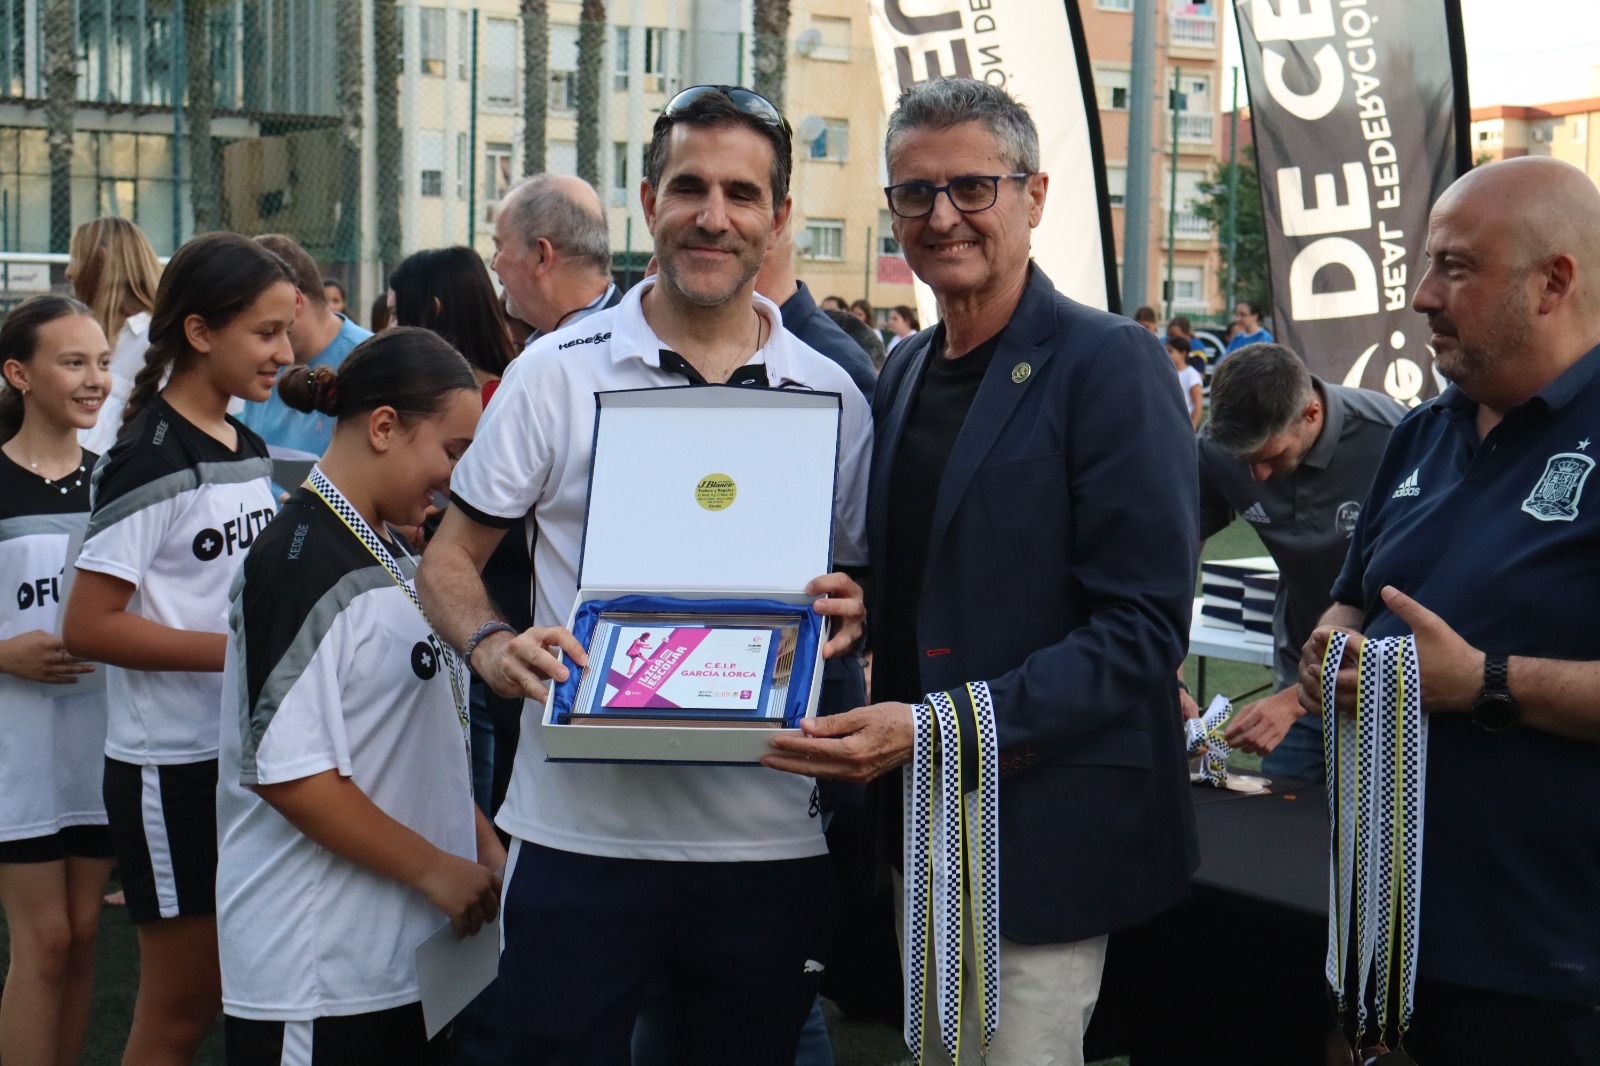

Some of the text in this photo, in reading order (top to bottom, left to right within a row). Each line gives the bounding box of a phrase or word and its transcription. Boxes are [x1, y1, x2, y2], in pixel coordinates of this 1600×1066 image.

[639, 660, 666, 684] LIGA
[646, 646, 688, 687] ESCOLAR
[681, 669, 720, 677] GARCÍA
